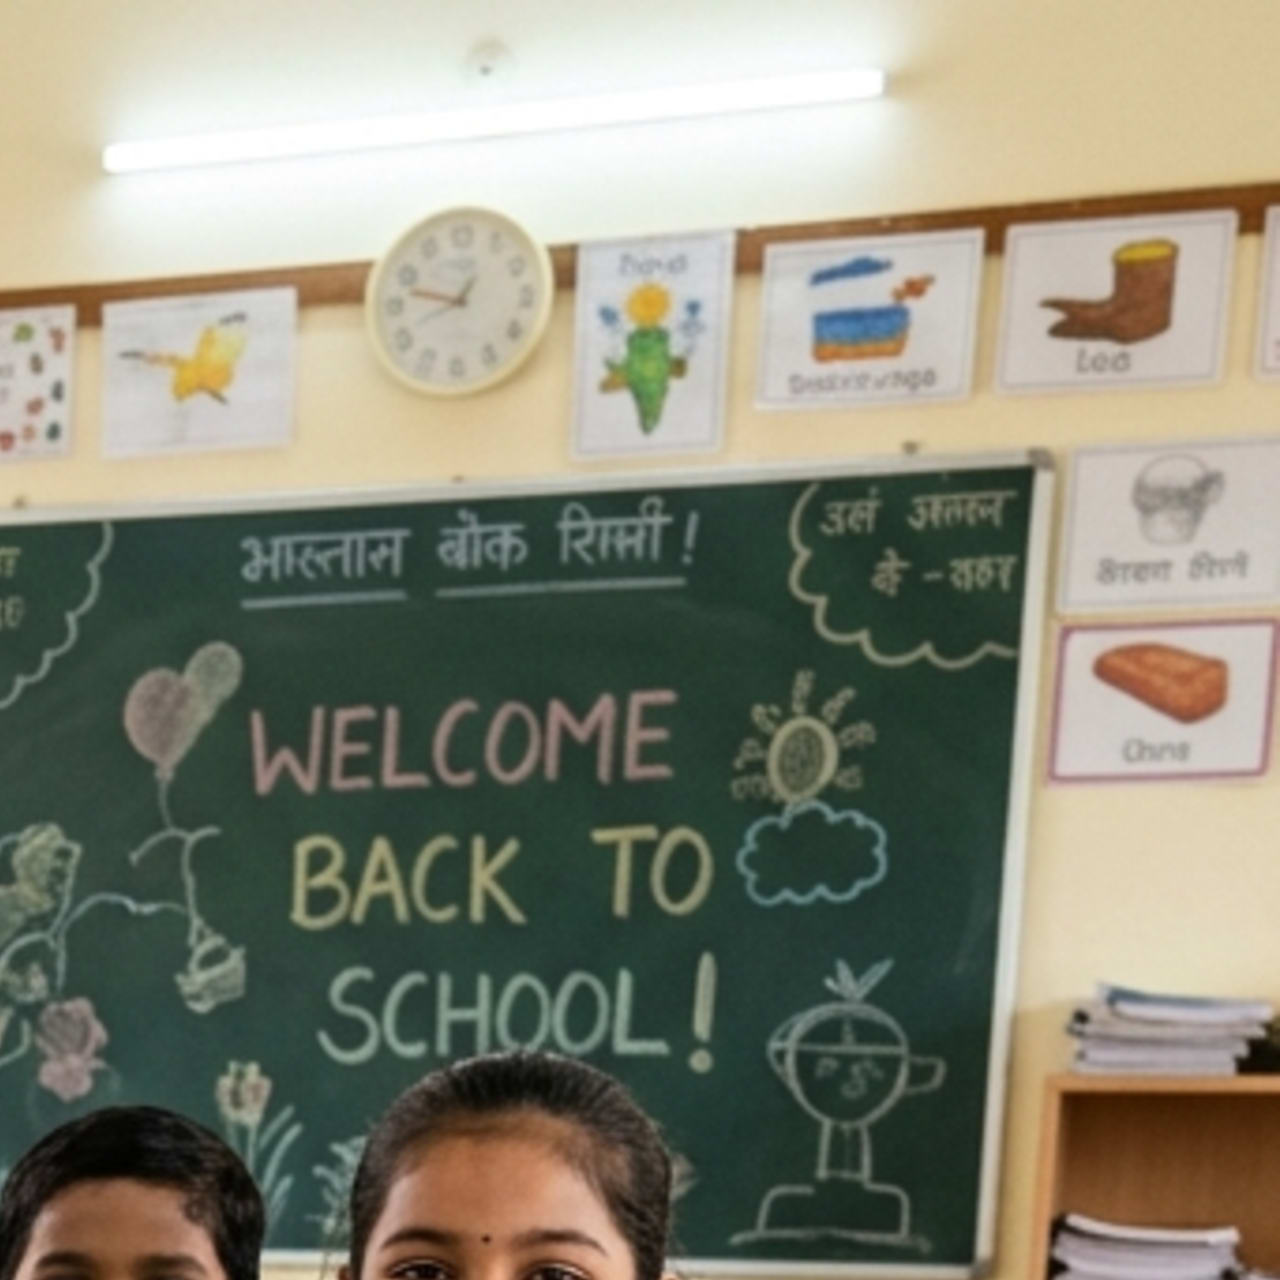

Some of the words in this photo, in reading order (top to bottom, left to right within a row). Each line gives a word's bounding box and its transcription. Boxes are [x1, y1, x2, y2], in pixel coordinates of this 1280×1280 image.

[250, 690, 679, 795] WELCOME
[290, 834, 527, 931] BACK
[591, 825, 713, 917] TO
